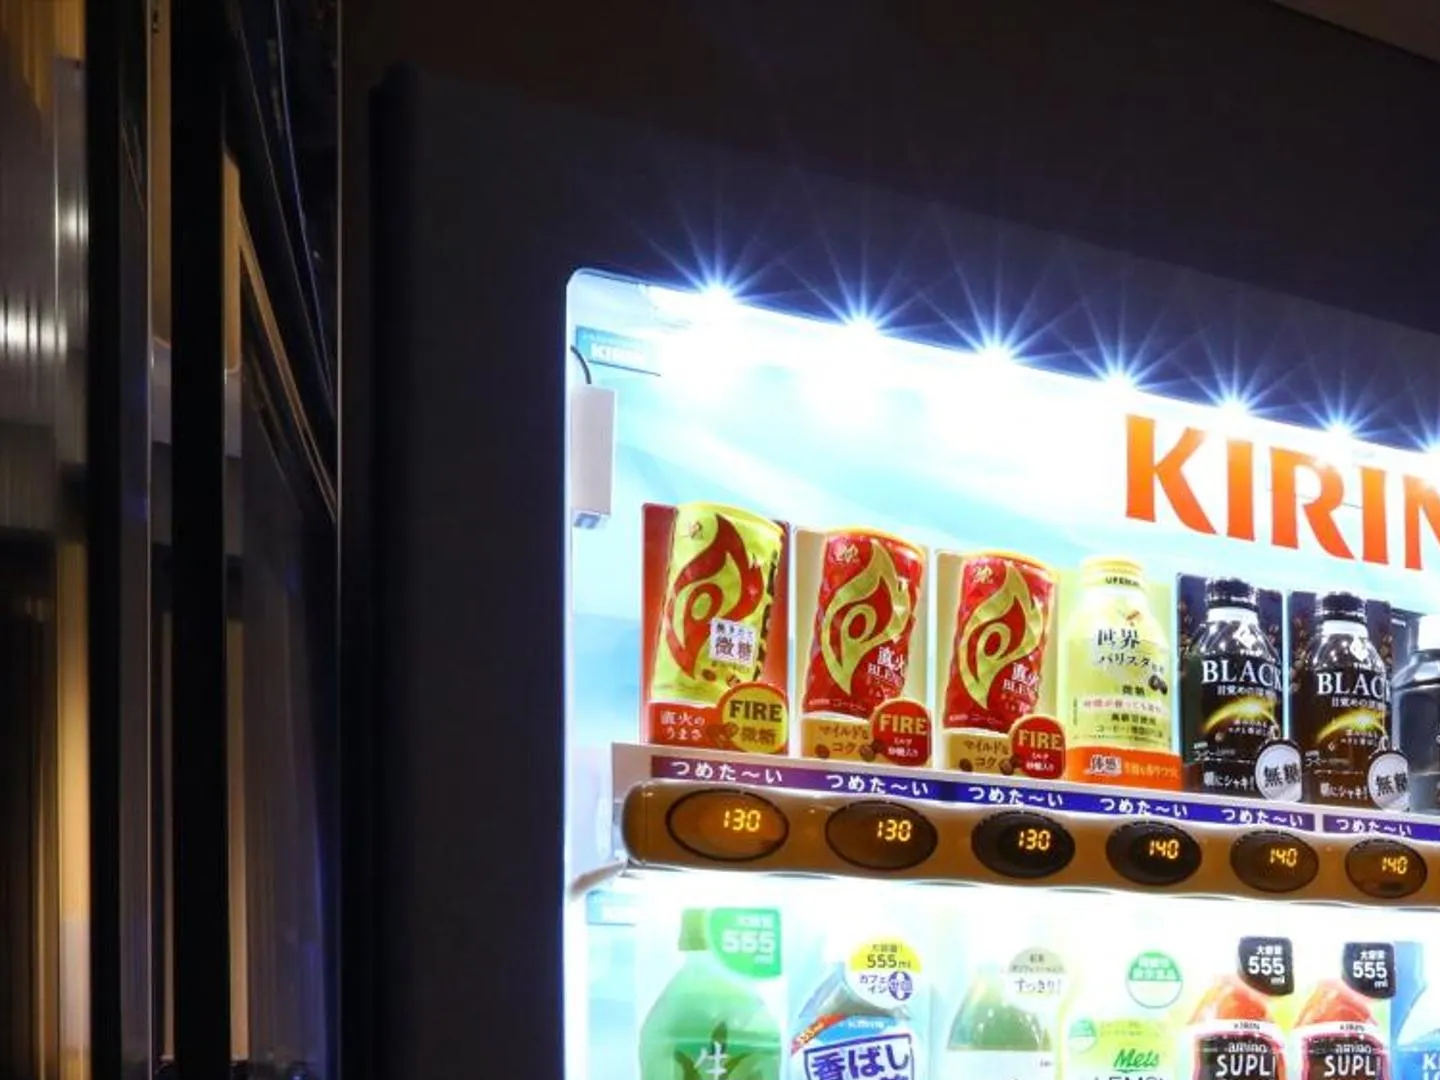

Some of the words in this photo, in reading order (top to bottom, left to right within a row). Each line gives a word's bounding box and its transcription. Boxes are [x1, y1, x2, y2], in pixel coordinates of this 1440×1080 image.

[715, 636, 753, 660] 微糖
[1202, 660, 1283, 692] BLACK
[729, 700, 783, 722] FIRE
[879, 713, 927, 735] FIRE
[1018, 729, 1063, 749] FIRE
[1264, 762, 1300, 788] 無糖
[723, 809, 761, 832] 130
[878, 820, 911, 842] 130
[1019, 830, 1051, 850] 130
[1150, 840, 1179, 859] 140
[1270, 848, 1297, 867] 140
[1382, 857, 1407, 875] 140
[867, 954, 897, 968] 555
[1248, 956, 1285, 974] 555
[1352, 961, 1387, 978] 555
